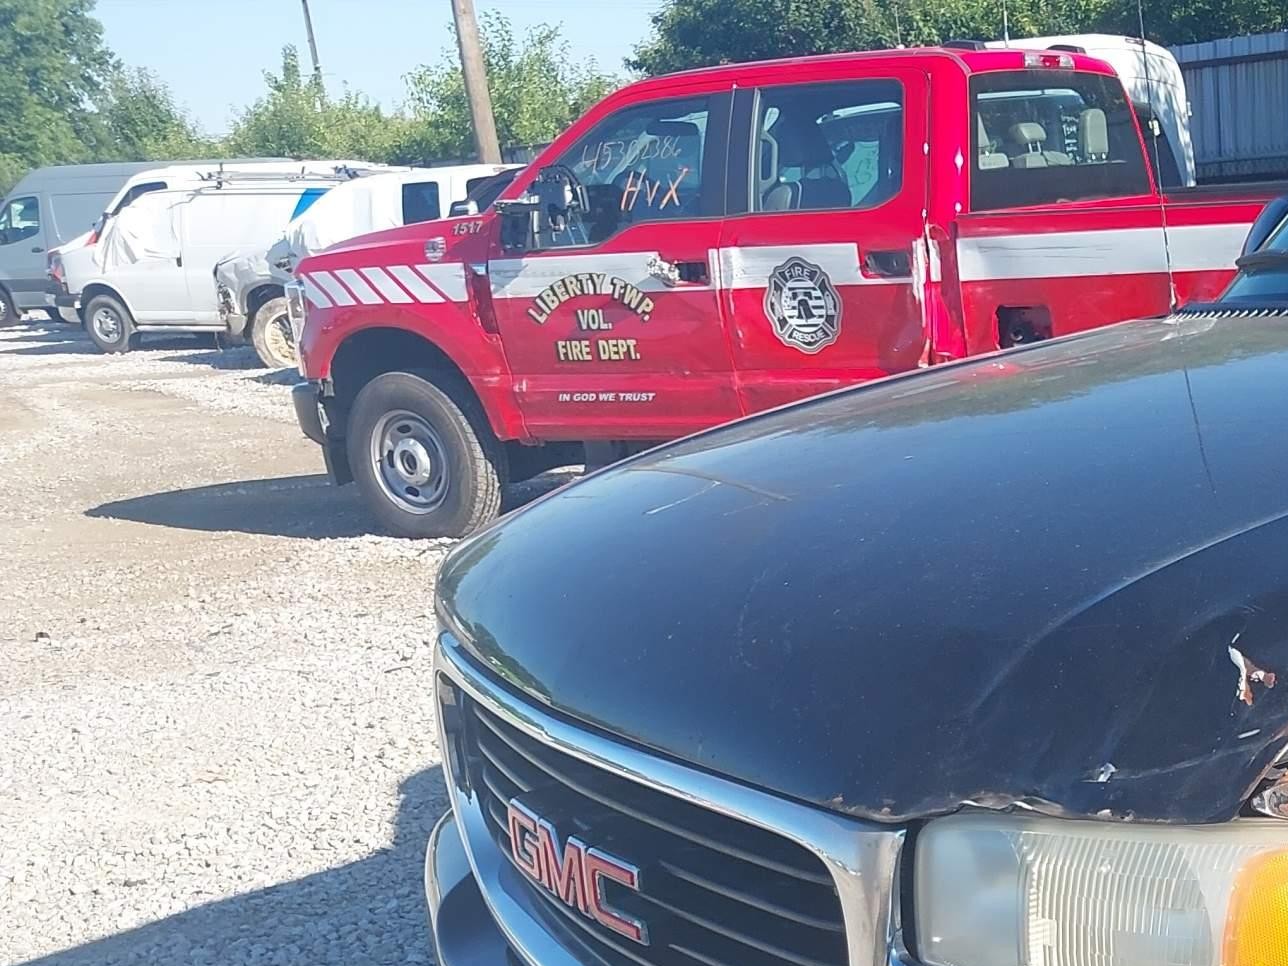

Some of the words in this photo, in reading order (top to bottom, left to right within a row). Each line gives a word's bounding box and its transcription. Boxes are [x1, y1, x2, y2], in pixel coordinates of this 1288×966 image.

[452, 221, 483, 236] 1517
[784, 266, 811, 280] FIRE
[527, 272, 607, 324] LIBERTY
[611, 276, 655, 322] TWP.
[577, 308, 613, 330] VOL.
[791, 329, 826, 343] RESCUE
[556, 339, 593, 361] FIRE
[598, 339, 641, 361] DEPT.
[558, 393, 571, 402] IN
[573, 392, 597, 402] GOD
[599, 392, 616, 402] WE
[618, 392, 656, 402] TRUST
[507, 798, 650, 947] GMC
